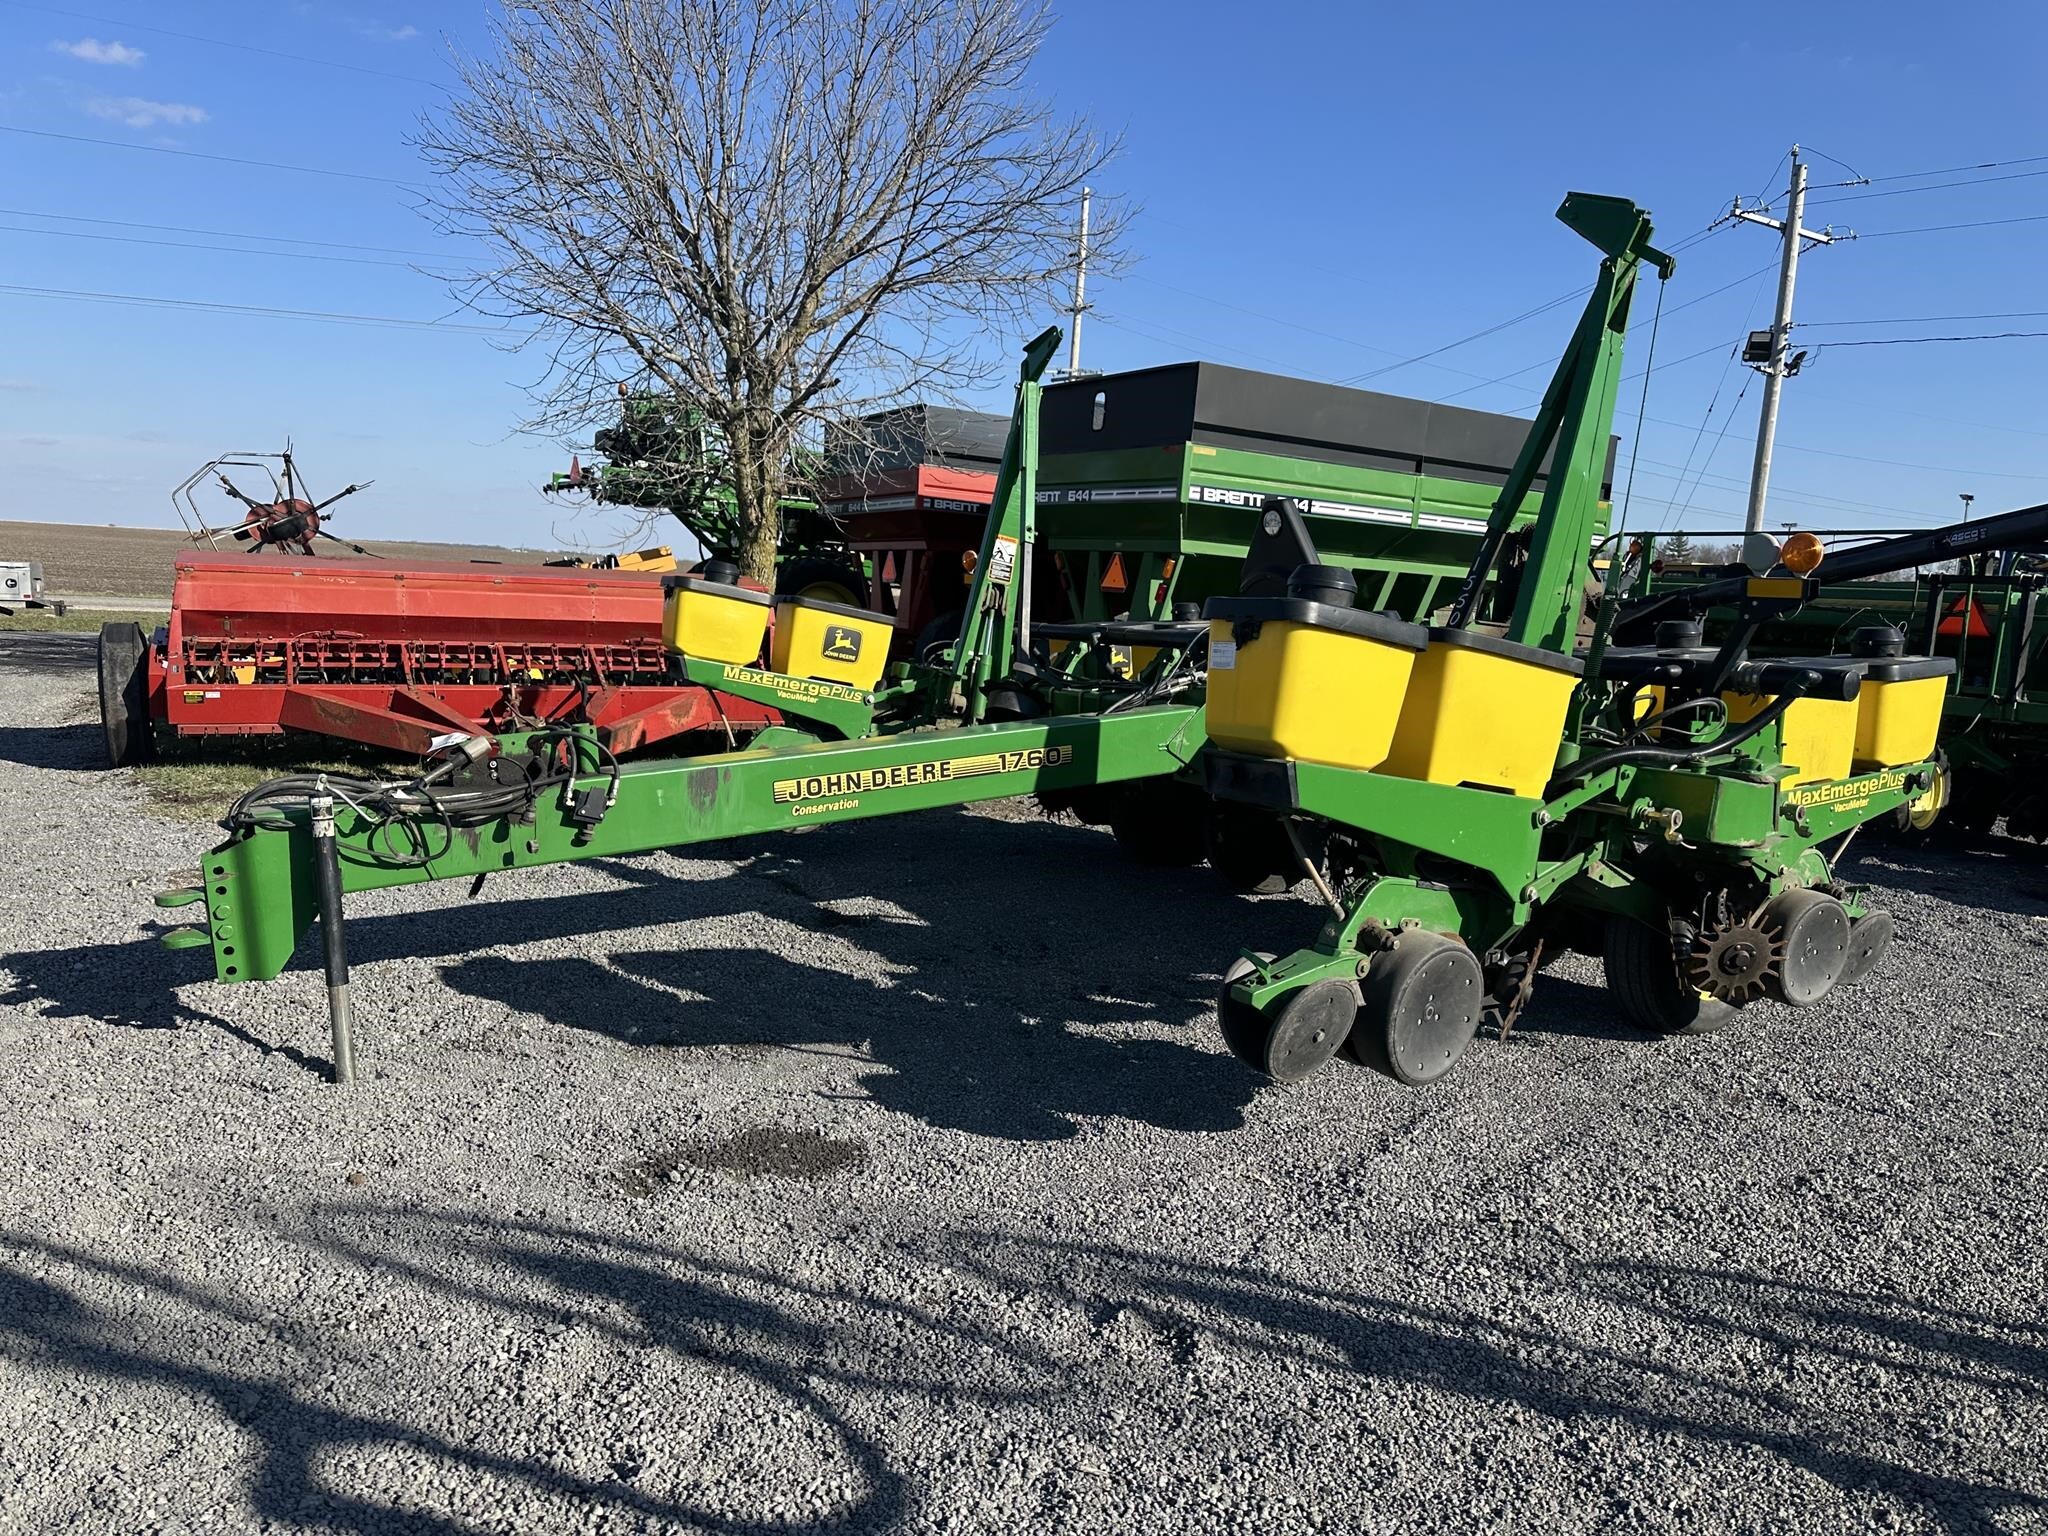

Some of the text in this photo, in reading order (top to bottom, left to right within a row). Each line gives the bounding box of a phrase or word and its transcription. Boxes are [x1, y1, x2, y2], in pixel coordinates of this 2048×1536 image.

[1035, 490, 1090, 502] RENT 644
[1203, 487, 1265, 507] BRENT
[934, 500, 980, 512] BRENT
[824, 650, 857, 661] JOHN DEERE
[777, 689, 819, 704] VacuMeter
[788, 747, 1062, 800] JOHN DEERE 1760
[791, 798, 860, 817] Conservation
[1834, 798, 1870, 813] VacuMeter
